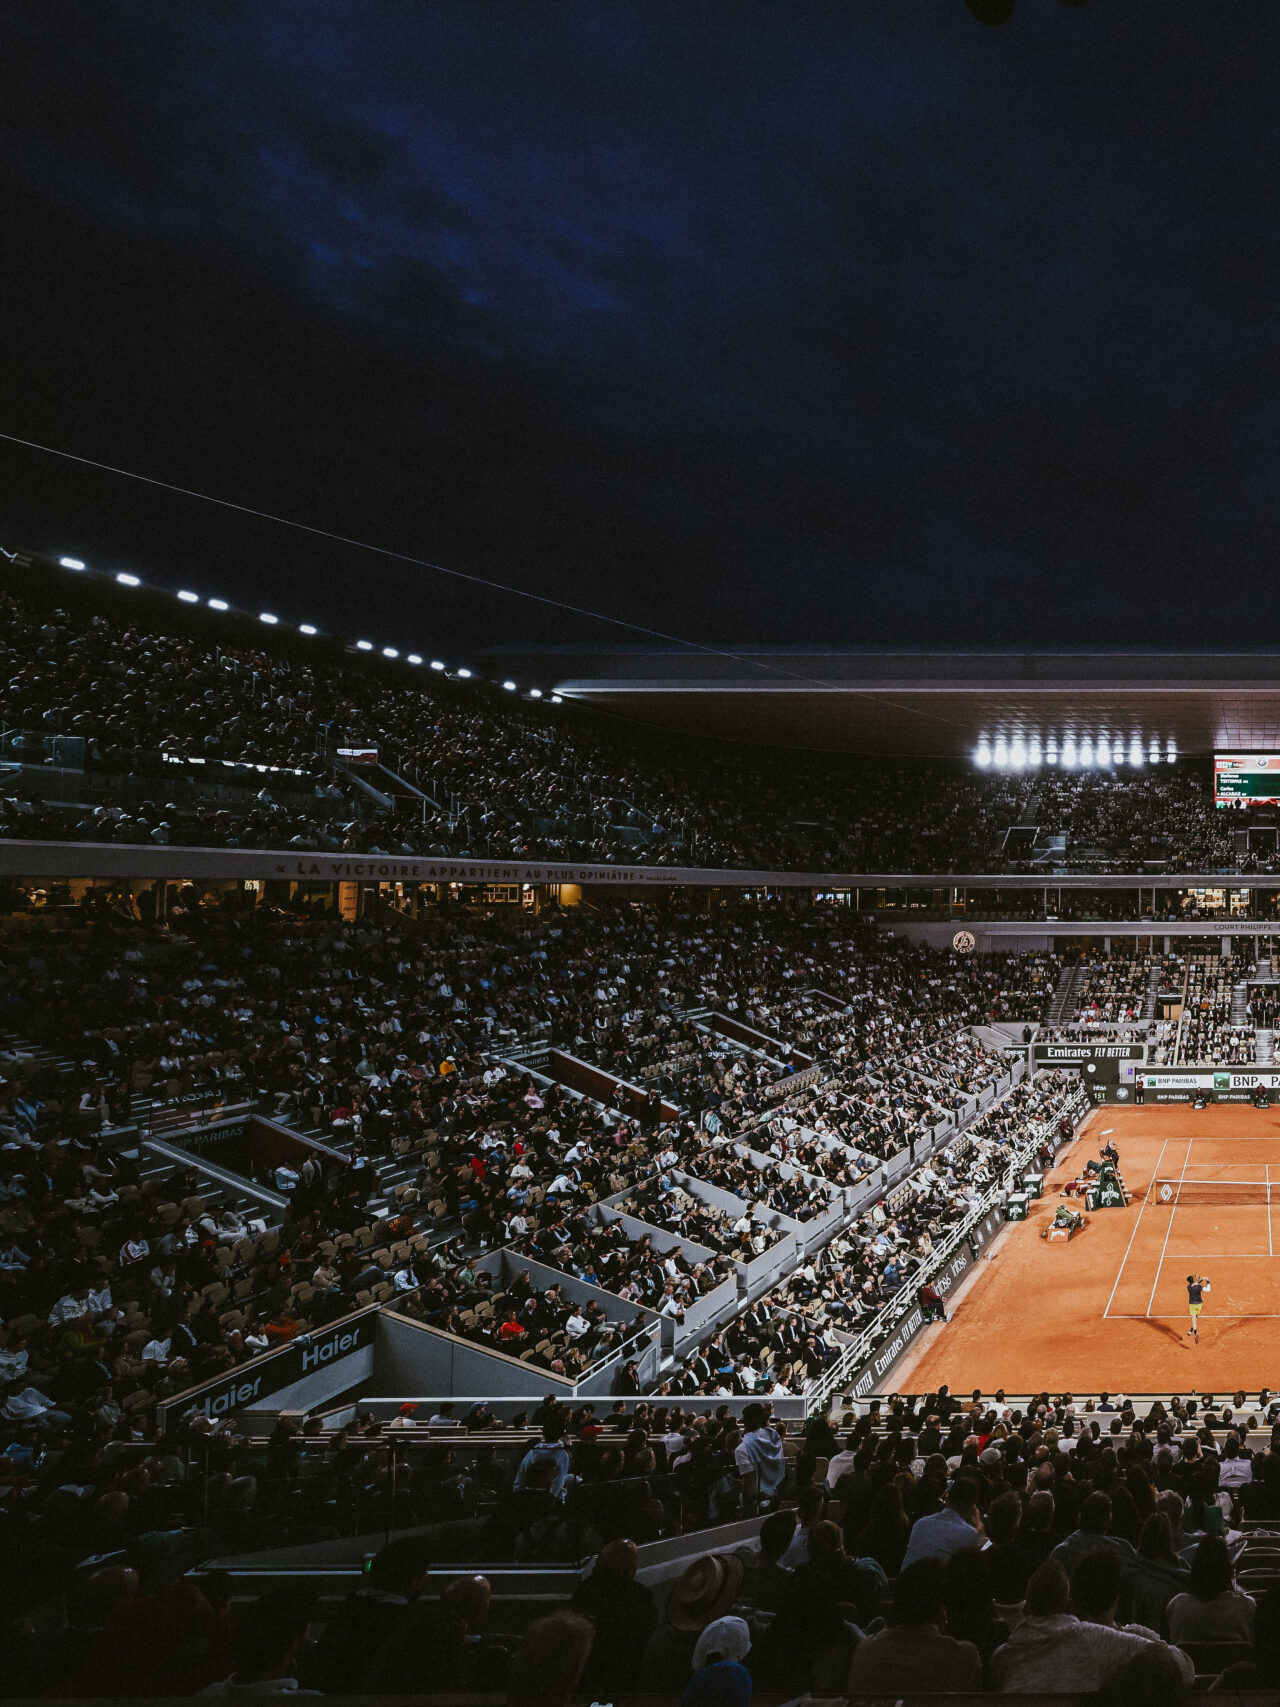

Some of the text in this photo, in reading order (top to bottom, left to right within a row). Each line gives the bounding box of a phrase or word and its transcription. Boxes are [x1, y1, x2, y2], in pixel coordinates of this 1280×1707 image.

[297, 863, 321, 875] LA
[332, 864, 420, 876] VICTOIRE
[429, 865, 518, 878] APPARTIENT
[525, 870, 541, 879] AU
[547, 870, 575, 879] PLUS
[580, 869, 635, 880] OPINIÂTRE
[1047, 1047, 1131, 1058] Emirates FLY BETTER
[1233, 1076, 1258, 1086] BNP
[194, 1126, 244, 1146] PARIBAS
[302, 1327, 361, 1372] Haier
[874, 1308, 923, 1376] Emirates FLY BETTER
[191, 1375, 262, 1418] Haier
